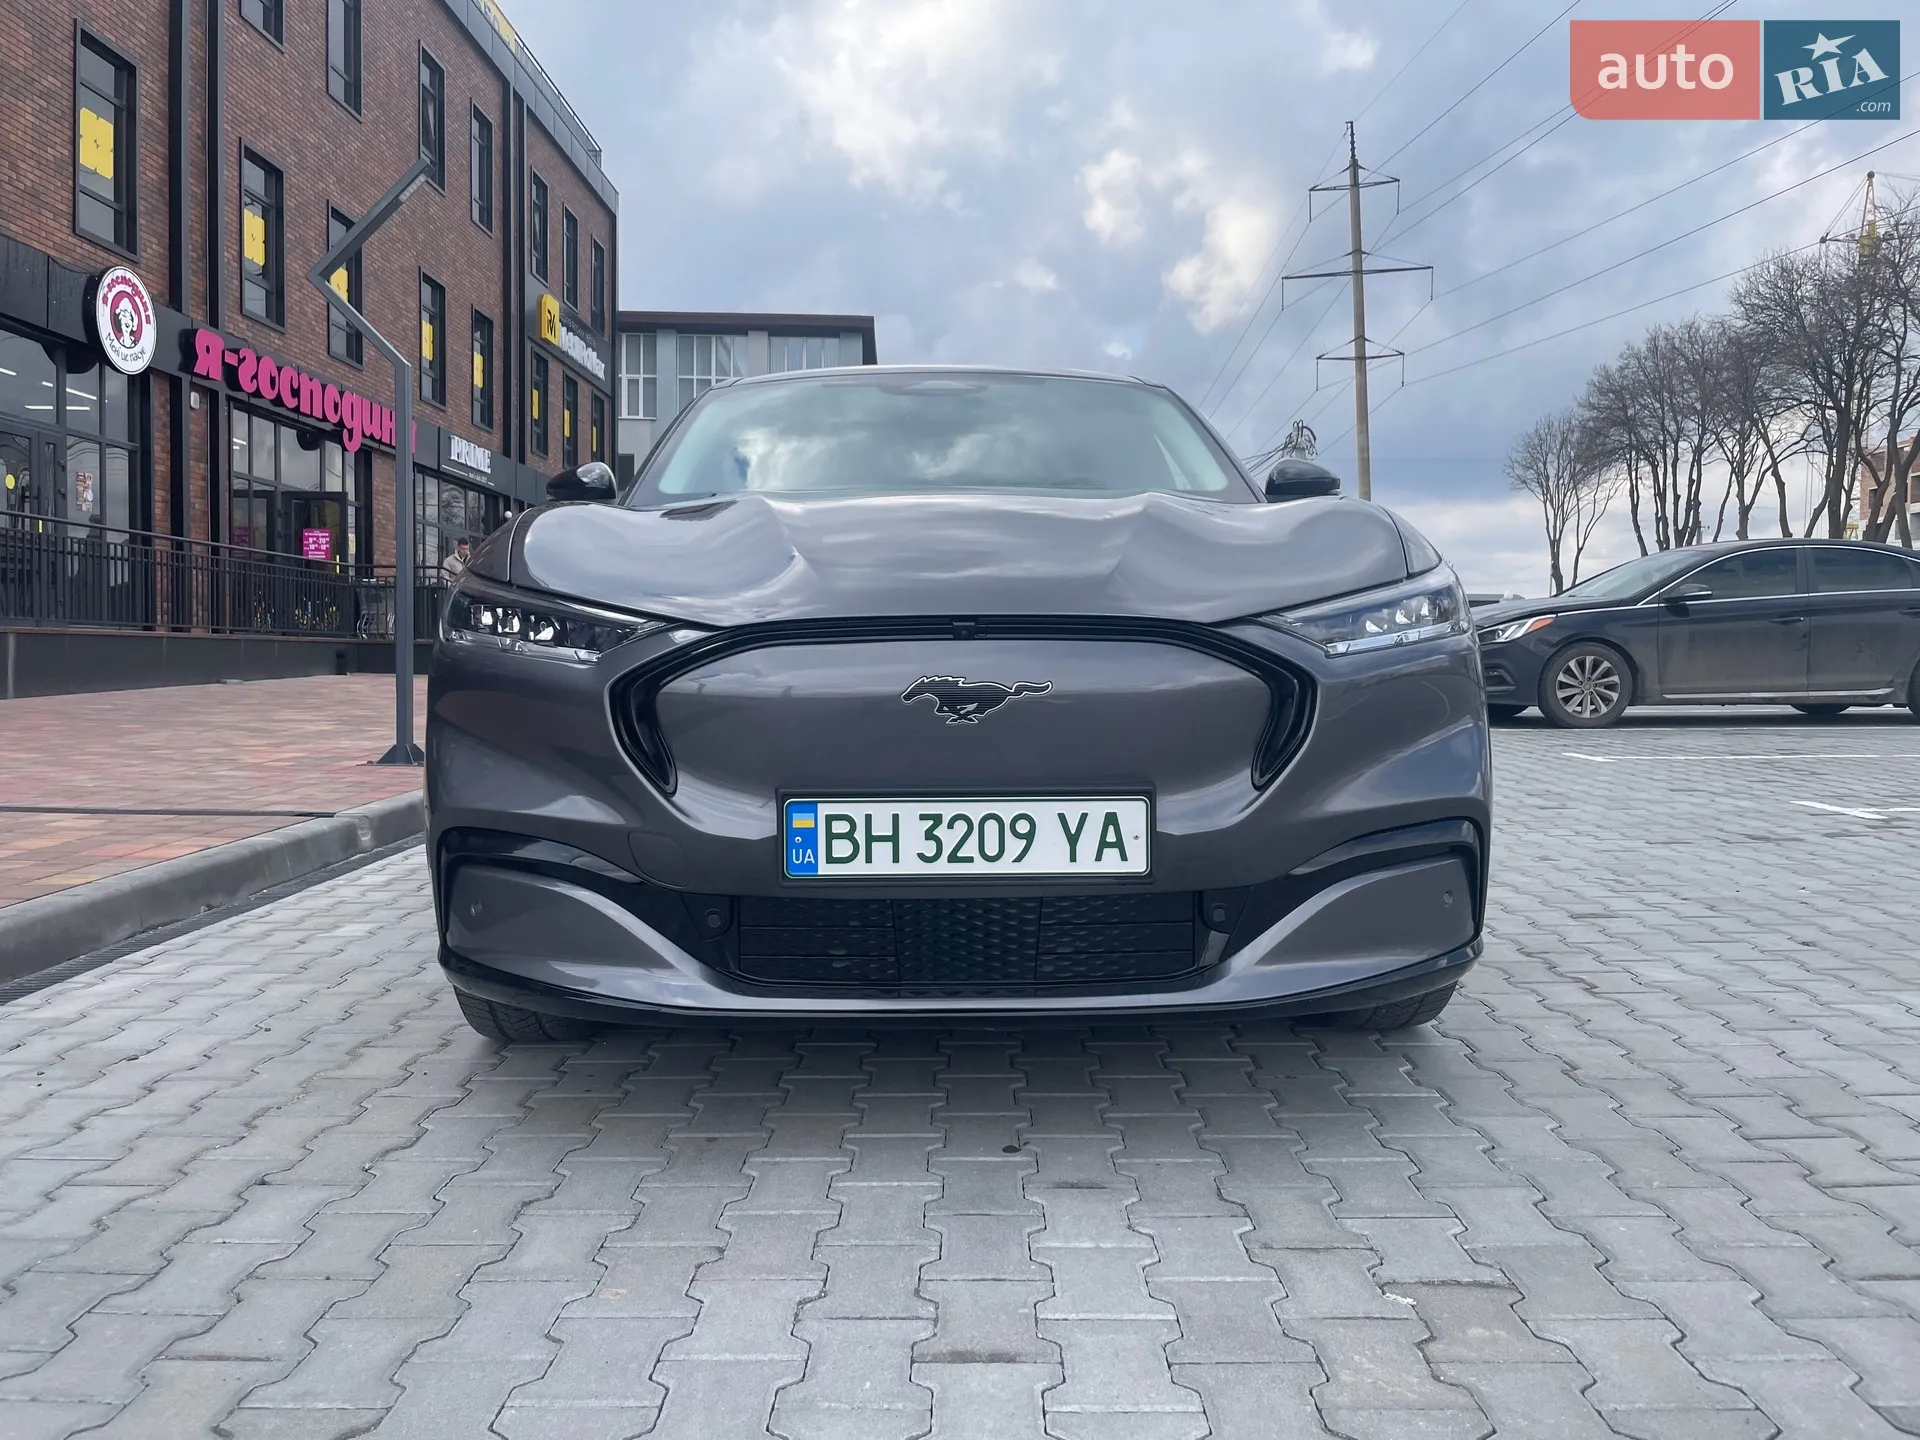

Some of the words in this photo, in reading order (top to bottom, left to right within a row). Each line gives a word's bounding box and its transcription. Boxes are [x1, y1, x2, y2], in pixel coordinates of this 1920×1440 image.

[449, 435, 491, 474] PRIME
[792, 848, 815, 865] UA
[825, 812, 901, 865] BH
[916, 812, 1037, 864] 3209
[1058, 811, 1129, 863] YA
